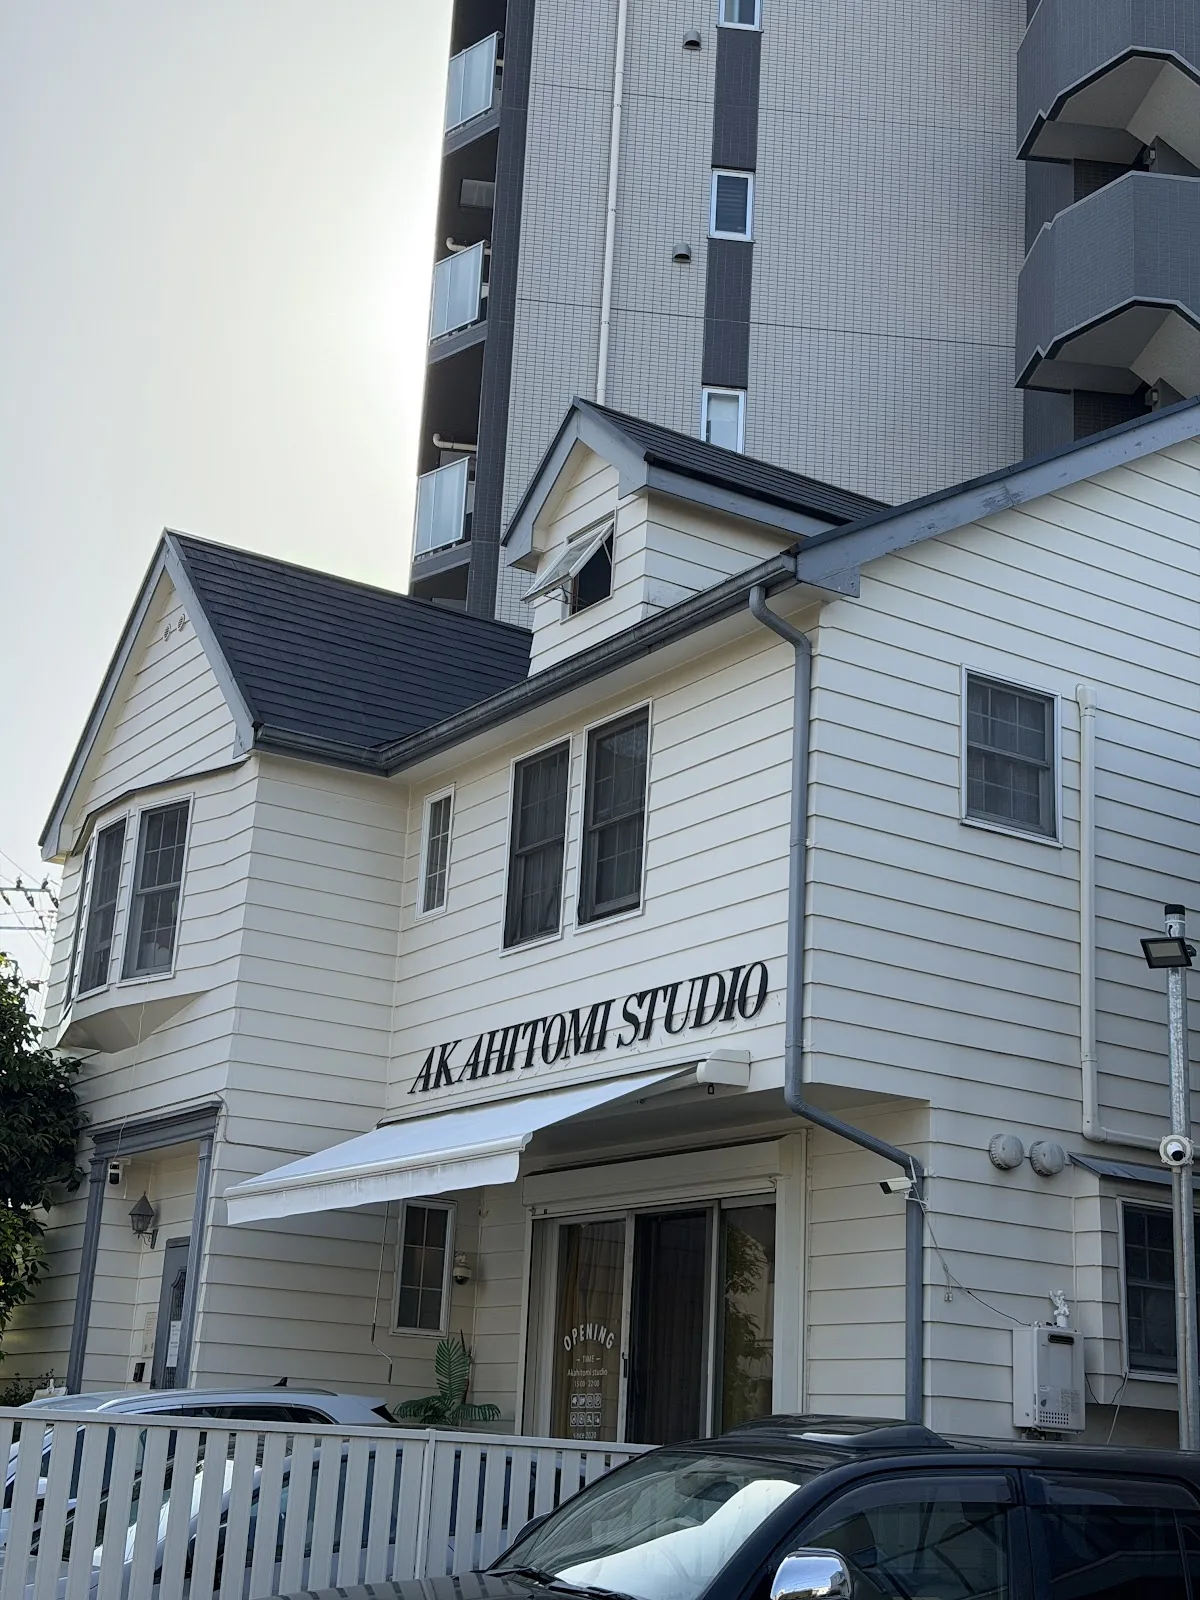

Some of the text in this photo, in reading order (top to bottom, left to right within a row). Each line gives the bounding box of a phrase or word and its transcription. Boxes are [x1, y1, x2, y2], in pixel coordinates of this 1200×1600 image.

[407, 961, 769, 1094] AKAHITOMI STUDIO
[564, 1323, 615, 1351] OPENING
